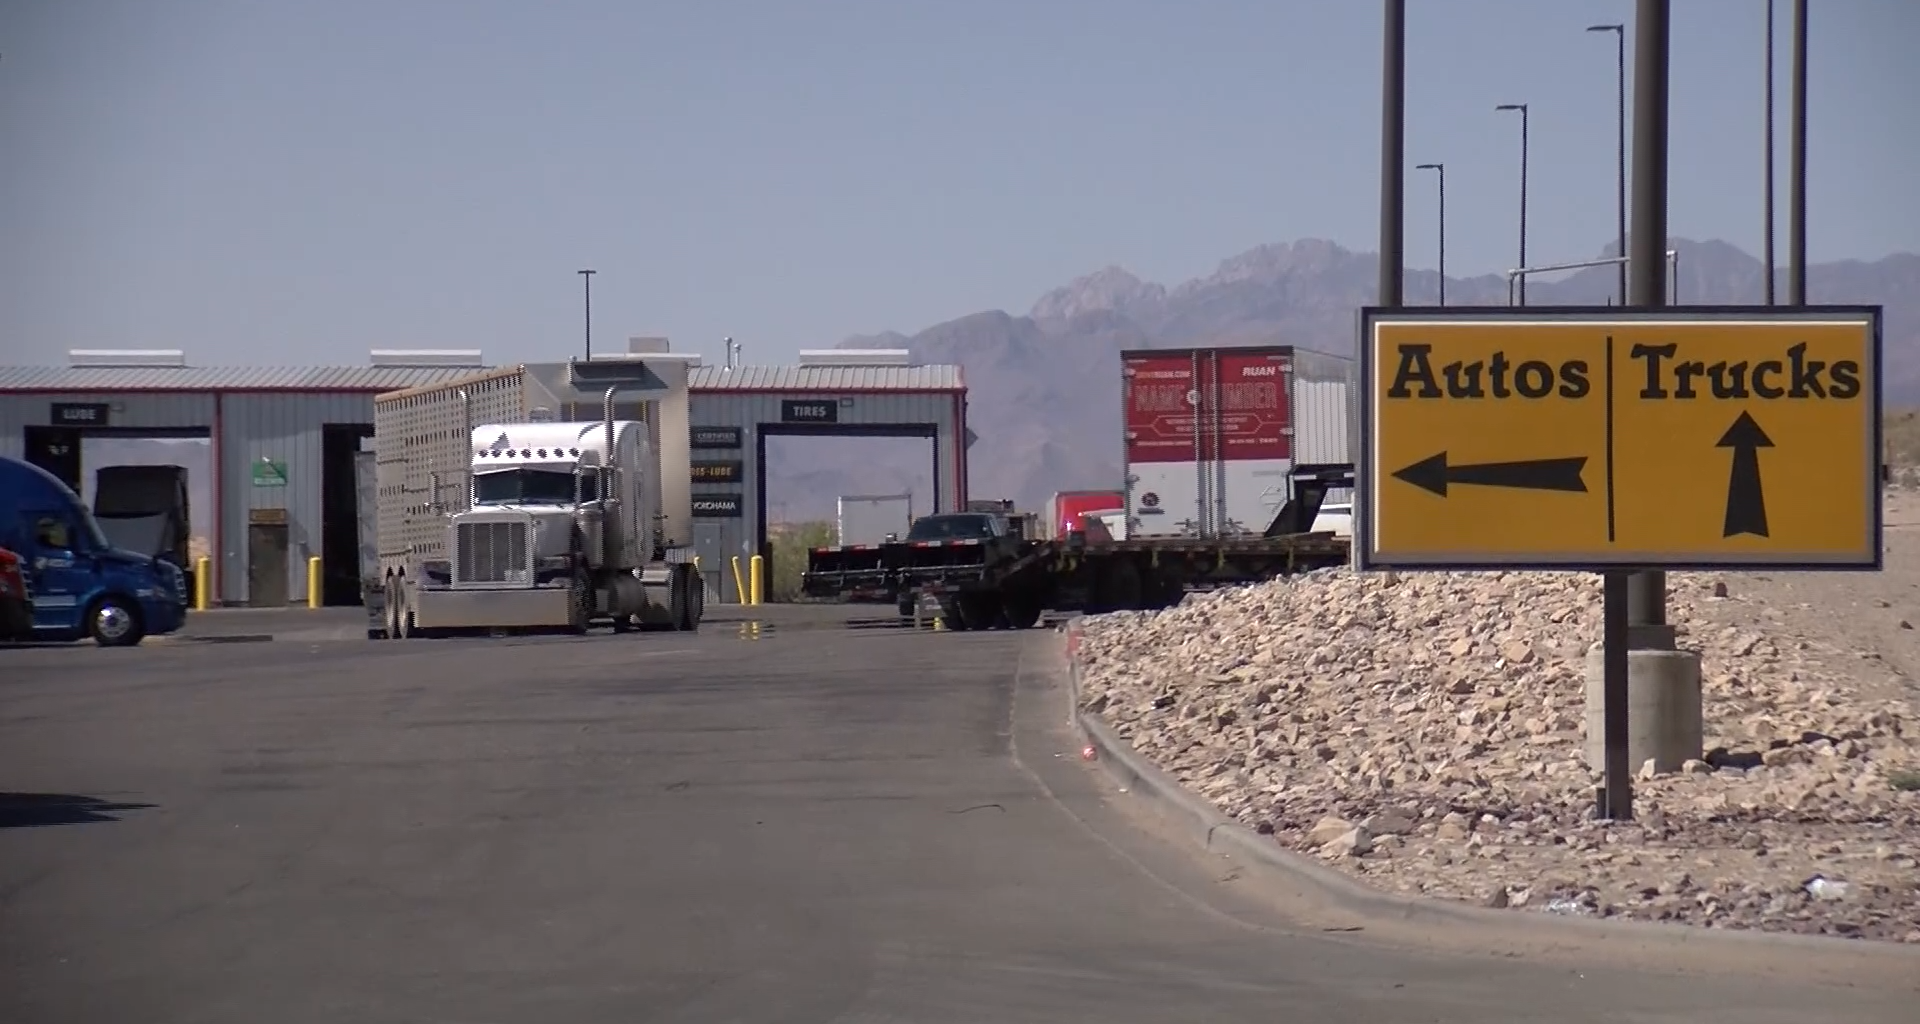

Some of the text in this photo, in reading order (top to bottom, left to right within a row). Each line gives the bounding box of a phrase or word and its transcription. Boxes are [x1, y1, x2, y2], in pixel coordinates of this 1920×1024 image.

[1242, 366, 1276, 377] RUAN
[1387, 343, 1591, 401] Autos
[1631, 341, 1861, 401] Trucks
[792, 405, 827, 418] TIRES
[693, 501, 737, 511] YOKOHAMA
